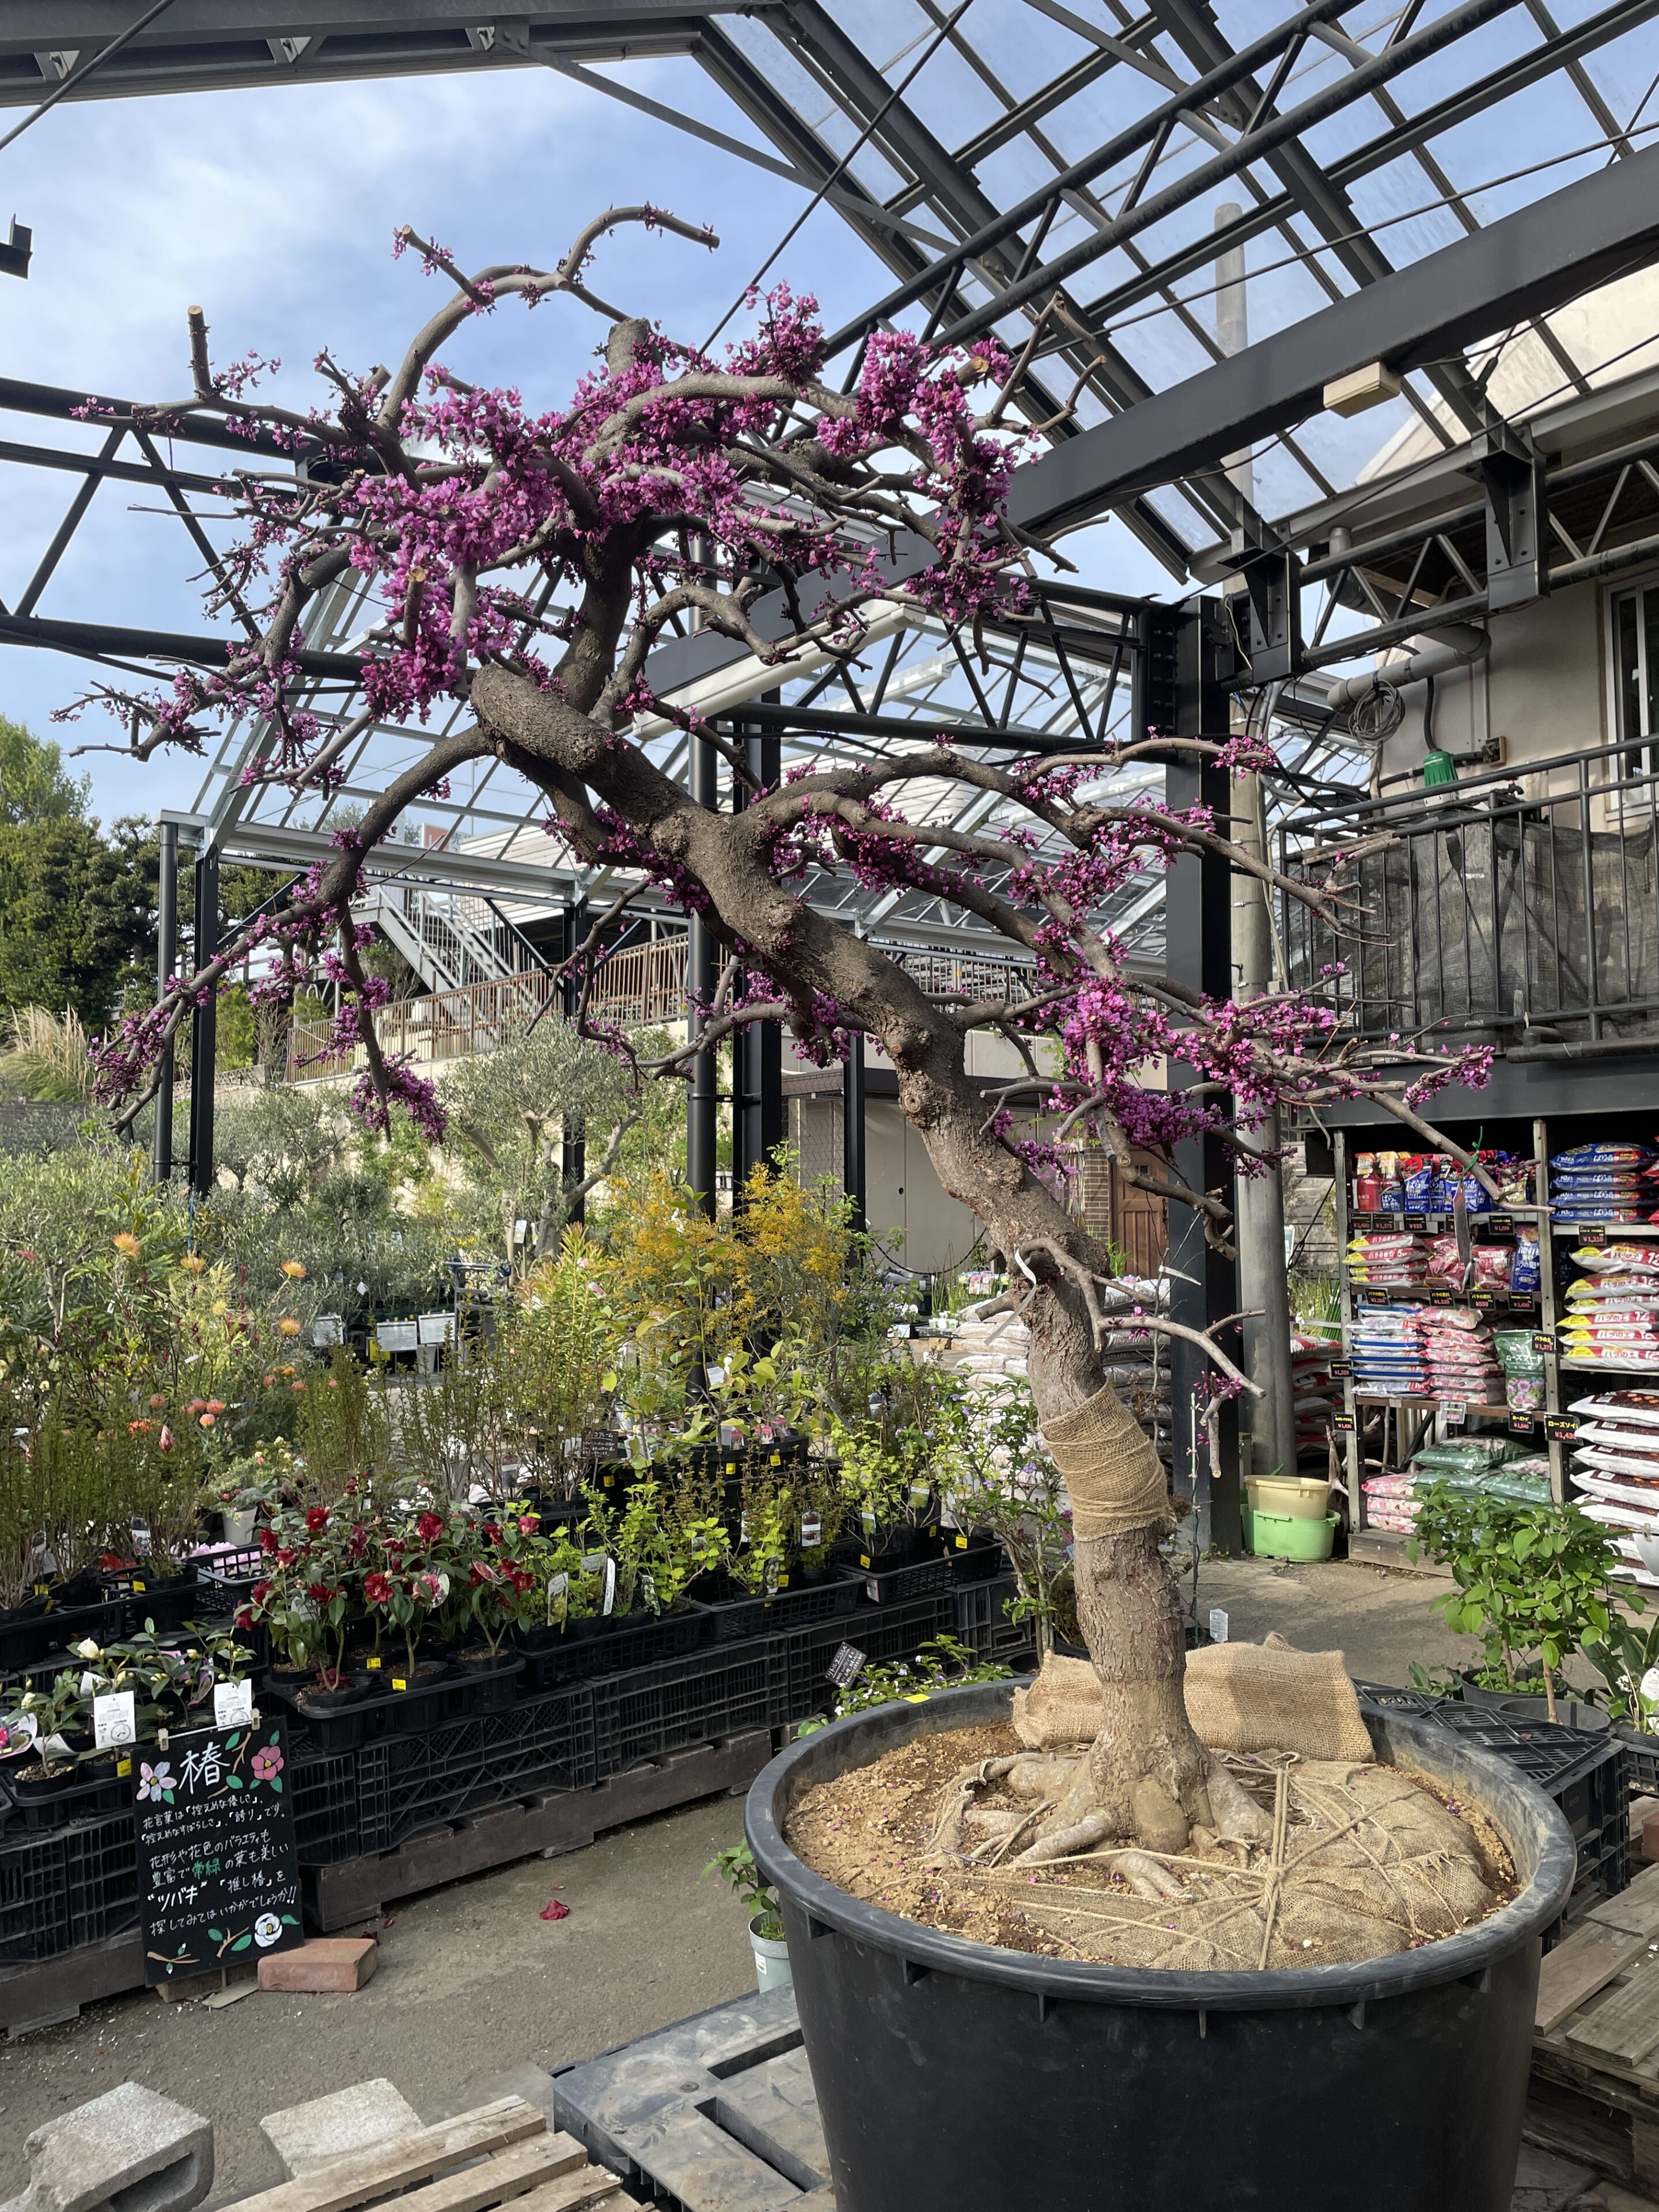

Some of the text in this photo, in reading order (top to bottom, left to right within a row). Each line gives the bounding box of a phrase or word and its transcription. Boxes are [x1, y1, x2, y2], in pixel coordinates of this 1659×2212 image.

[1548, 1421, 1578, 1429] ローズソイ
[179, 1741, 230, 1794] 椿
[149, 1828, 271, 1870] 花形や花色のバラエティも
